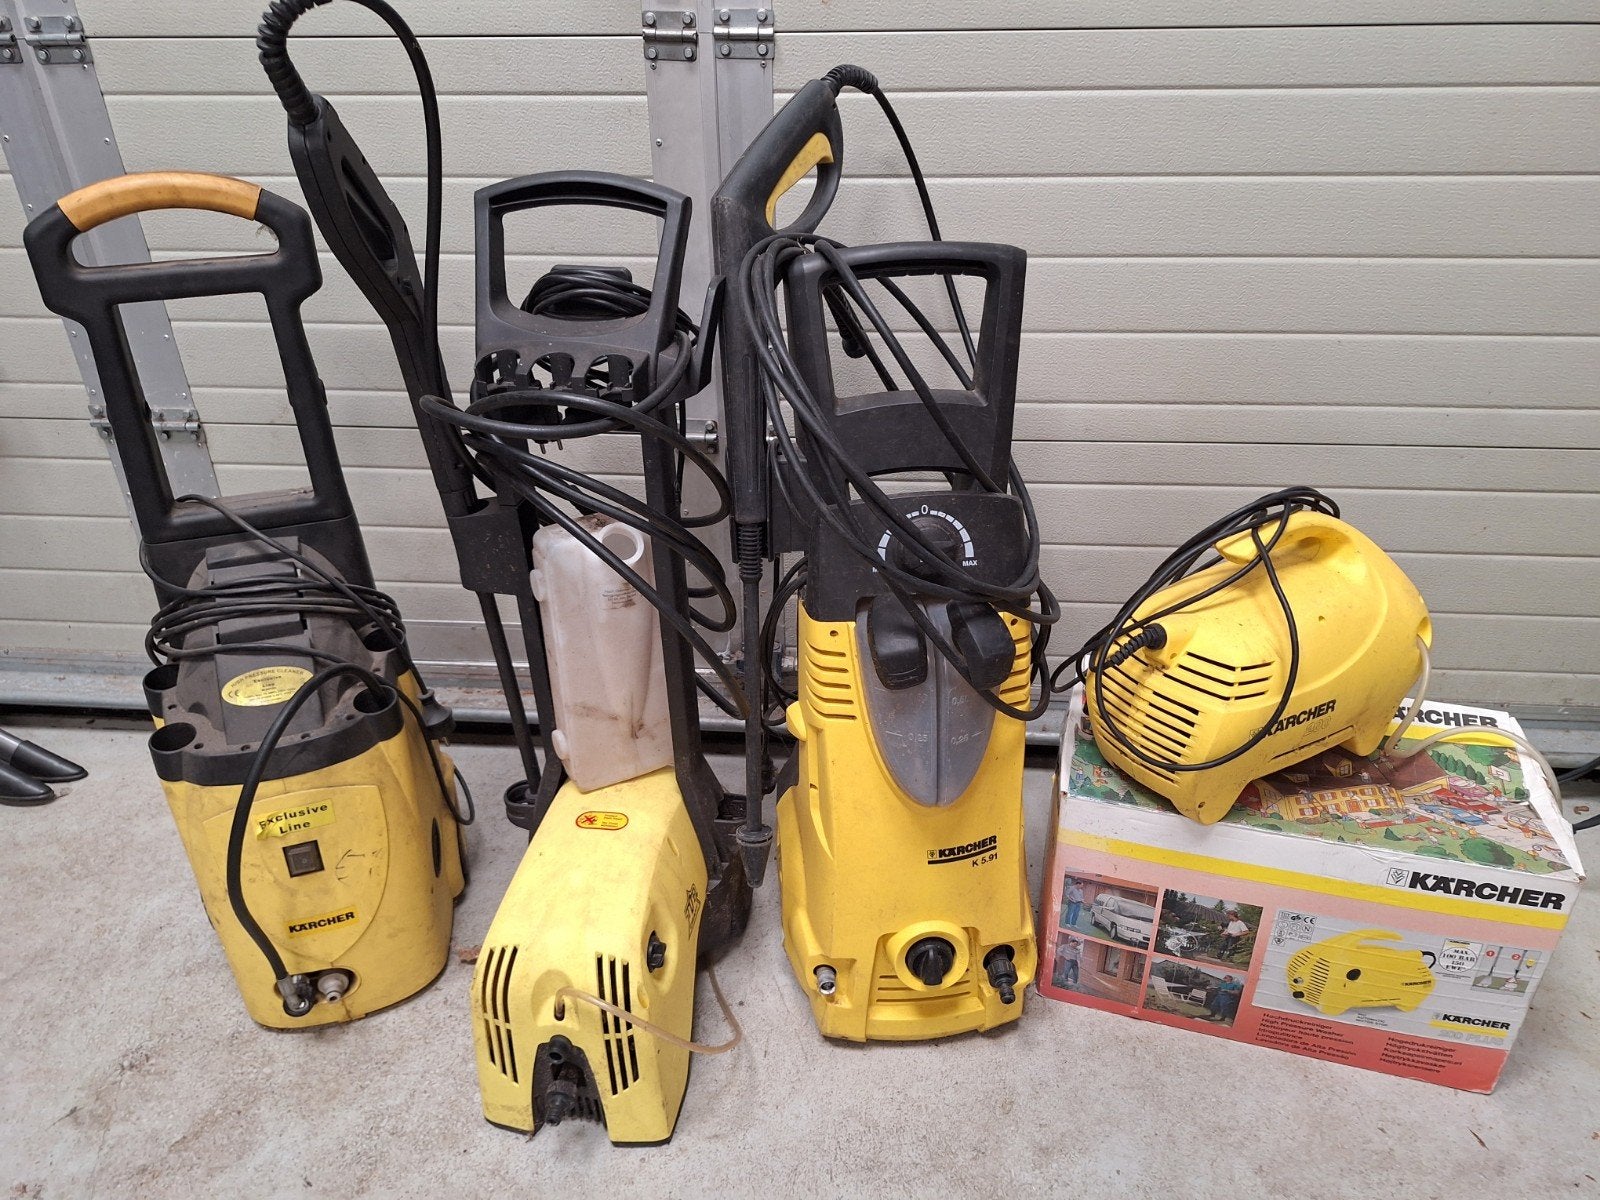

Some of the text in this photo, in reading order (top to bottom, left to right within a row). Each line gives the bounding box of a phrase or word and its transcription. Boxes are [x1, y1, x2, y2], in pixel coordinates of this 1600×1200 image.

[920, 504, 929, 515] 0
[962, 559, 978, 567] MAX
[245, 669, 275, 679] PRESSURE
[276, 668, 304, 676] CLEANER
[259, 804, 328, 830] Exclusive
[279, 821, 311, 834] Line
[938, 835, 997, 858] KÄRCHER
[972, 853, 998, 867] K 5.91
[1408, 871, 1566, 910] KÄRCHER
[288, 911, 355, 933] KÄRCHER
[1261, 1018, 1279, 1026] High
[1281, 1022, 1314, 1031] Pressure
[1263, 1013, 1332, 1030] Hochdruckreiniger
[1442, 1013, 1511, 1031] KÄRCHER
